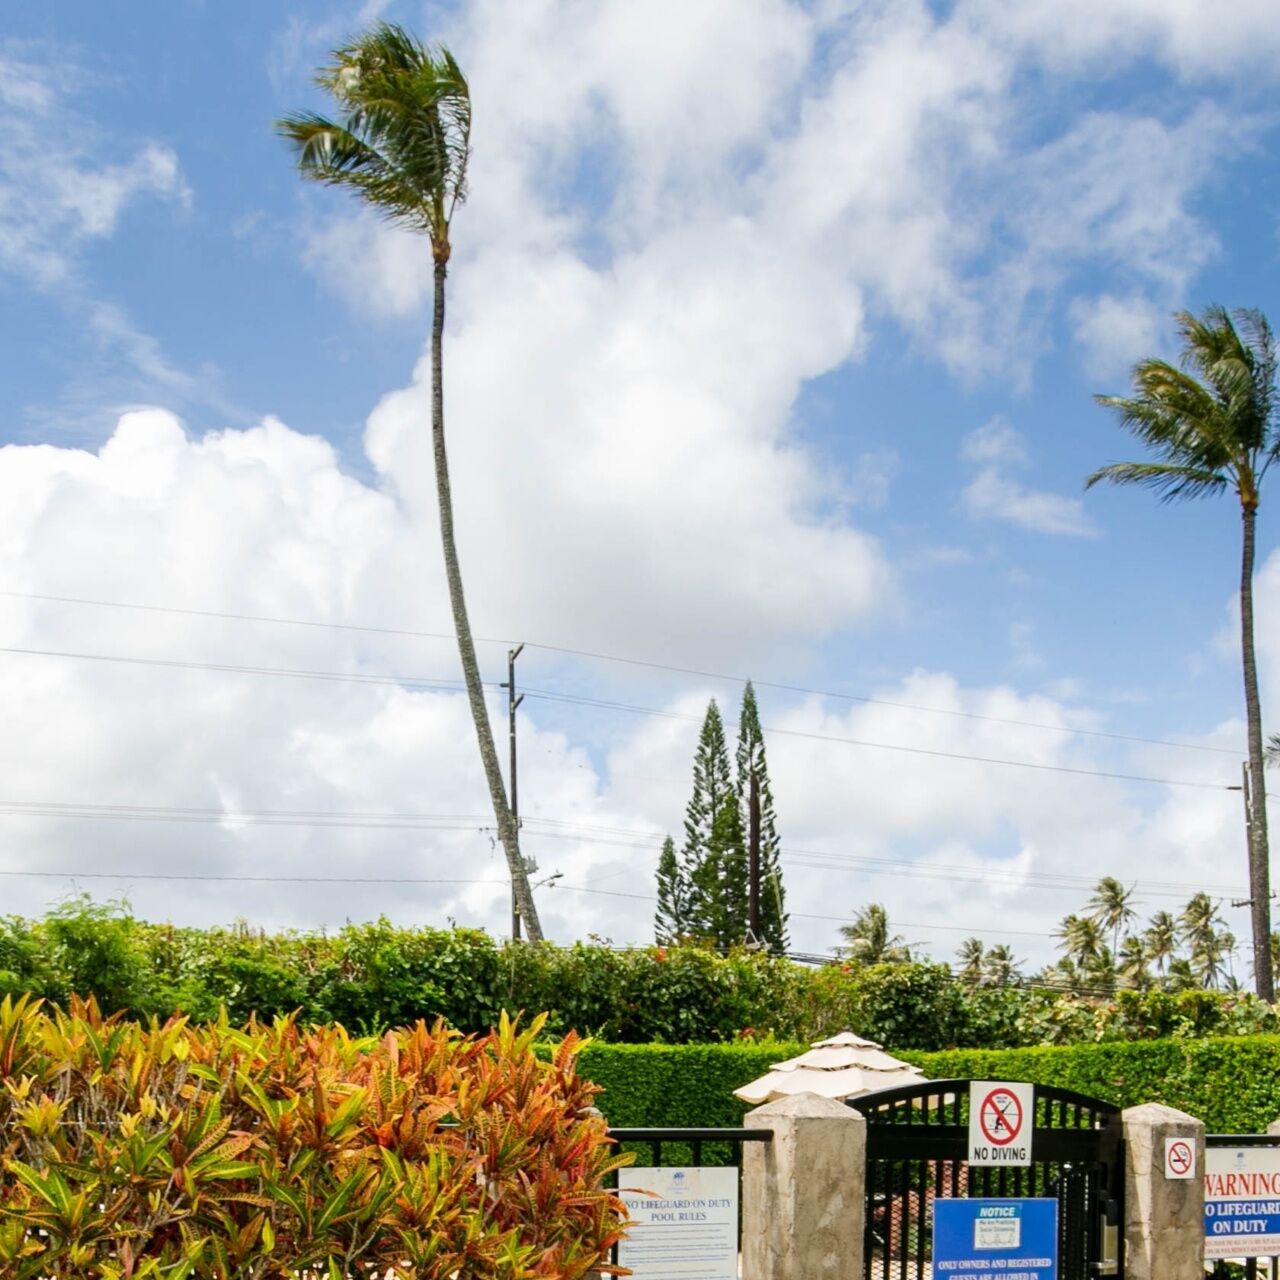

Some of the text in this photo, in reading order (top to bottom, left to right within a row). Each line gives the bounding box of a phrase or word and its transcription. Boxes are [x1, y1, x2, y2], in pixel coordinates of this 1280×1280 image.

[974, 1147, 1026, 1160] NO DIVING
[625, 1199, 731, 1209] NO LIFEGUARD ON DUTY
[979, 1207, 1016, 1217] NOTICE
[1205, 1204, 1215, 1217] O
[651, 1212, 707, 1221] POOL RULES
[1213, 1219, 1268, 1233] ON DUTY
[938, 1258, 1052, 1270] ONLY OWNERS AND REGISTERED
[1030, 1273, 1039, 1280] IN
